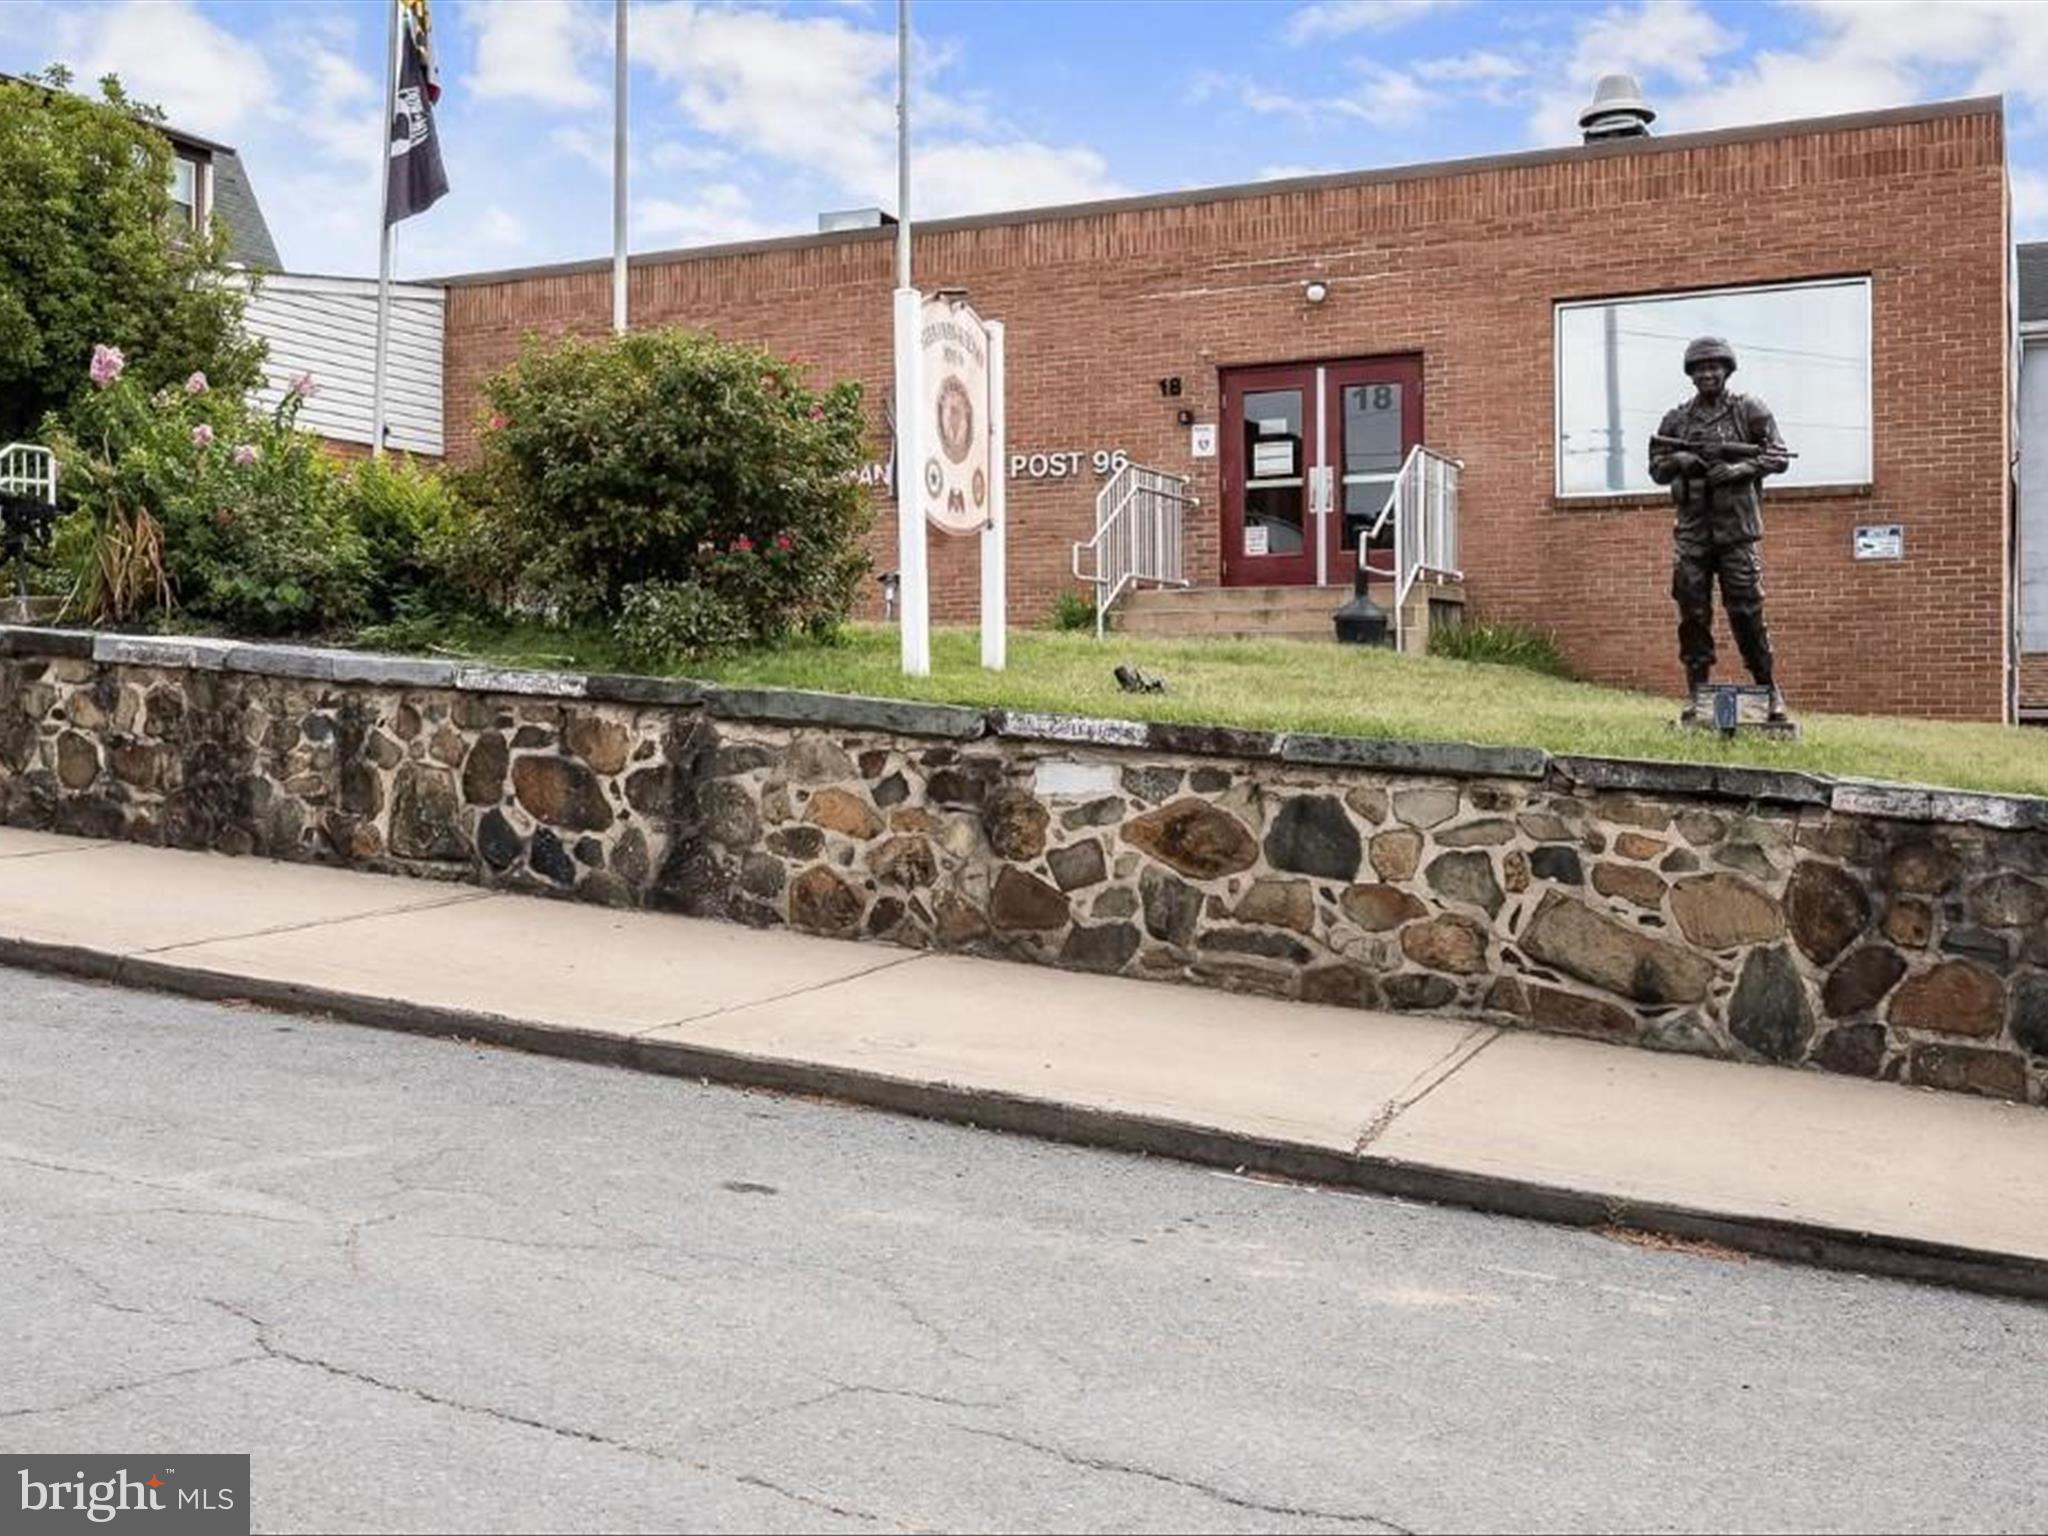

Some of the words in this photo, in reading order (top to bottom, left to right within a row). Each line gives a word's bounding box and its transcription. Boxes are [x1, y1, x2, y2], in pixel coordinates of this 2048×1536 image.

[1159, 377, 1182, 397] 18
[1353, 386, 1393, 411] 18
[1010, 451, 1085, 478] POST
[1092, 448, 1128, 475] 96
